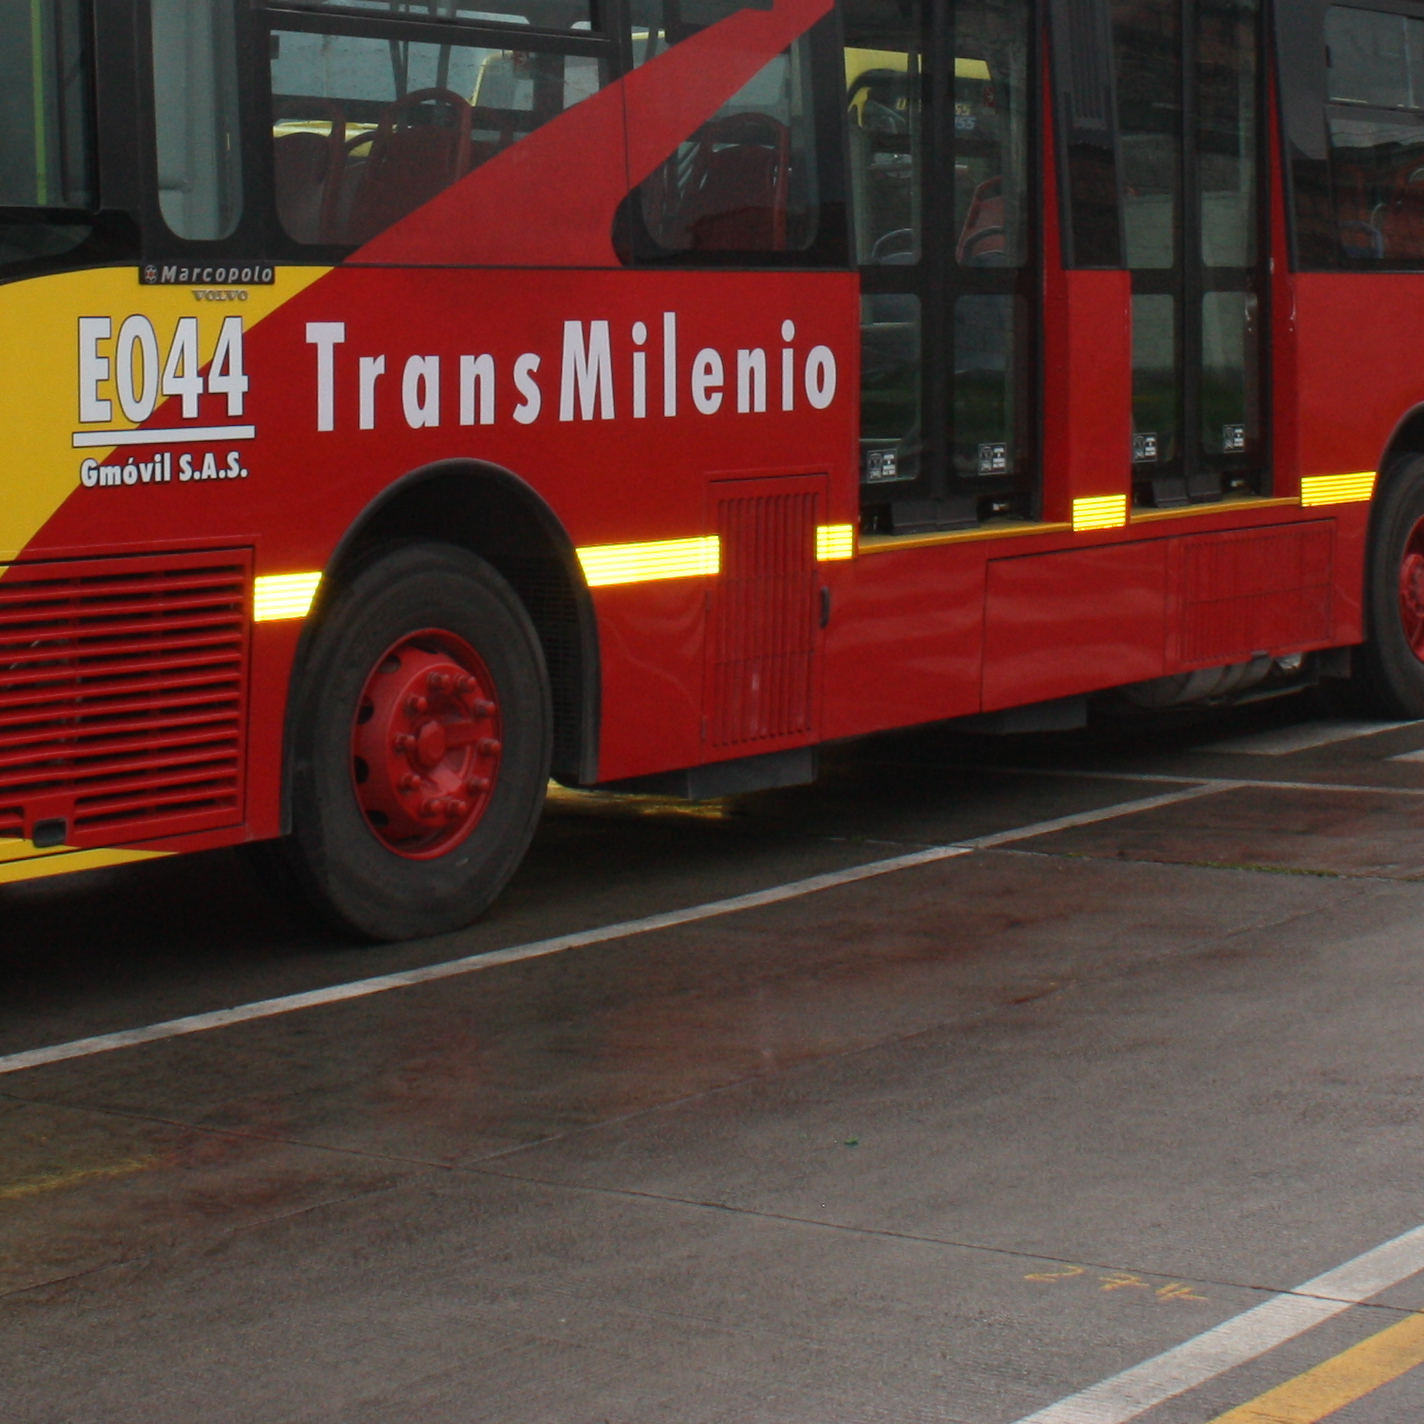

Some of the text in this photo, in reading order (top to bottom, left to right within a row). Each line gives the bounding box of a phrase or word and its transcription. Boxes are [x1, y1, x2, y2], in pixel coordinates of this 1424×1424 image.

[160, 265, 273, 284] Marcopolo
[191, 288, 249, 302] VOLVO
[305, 311, 837, 432] TransMilenio
[80, 450, 249, 488] Gmóvil S.A.S.
